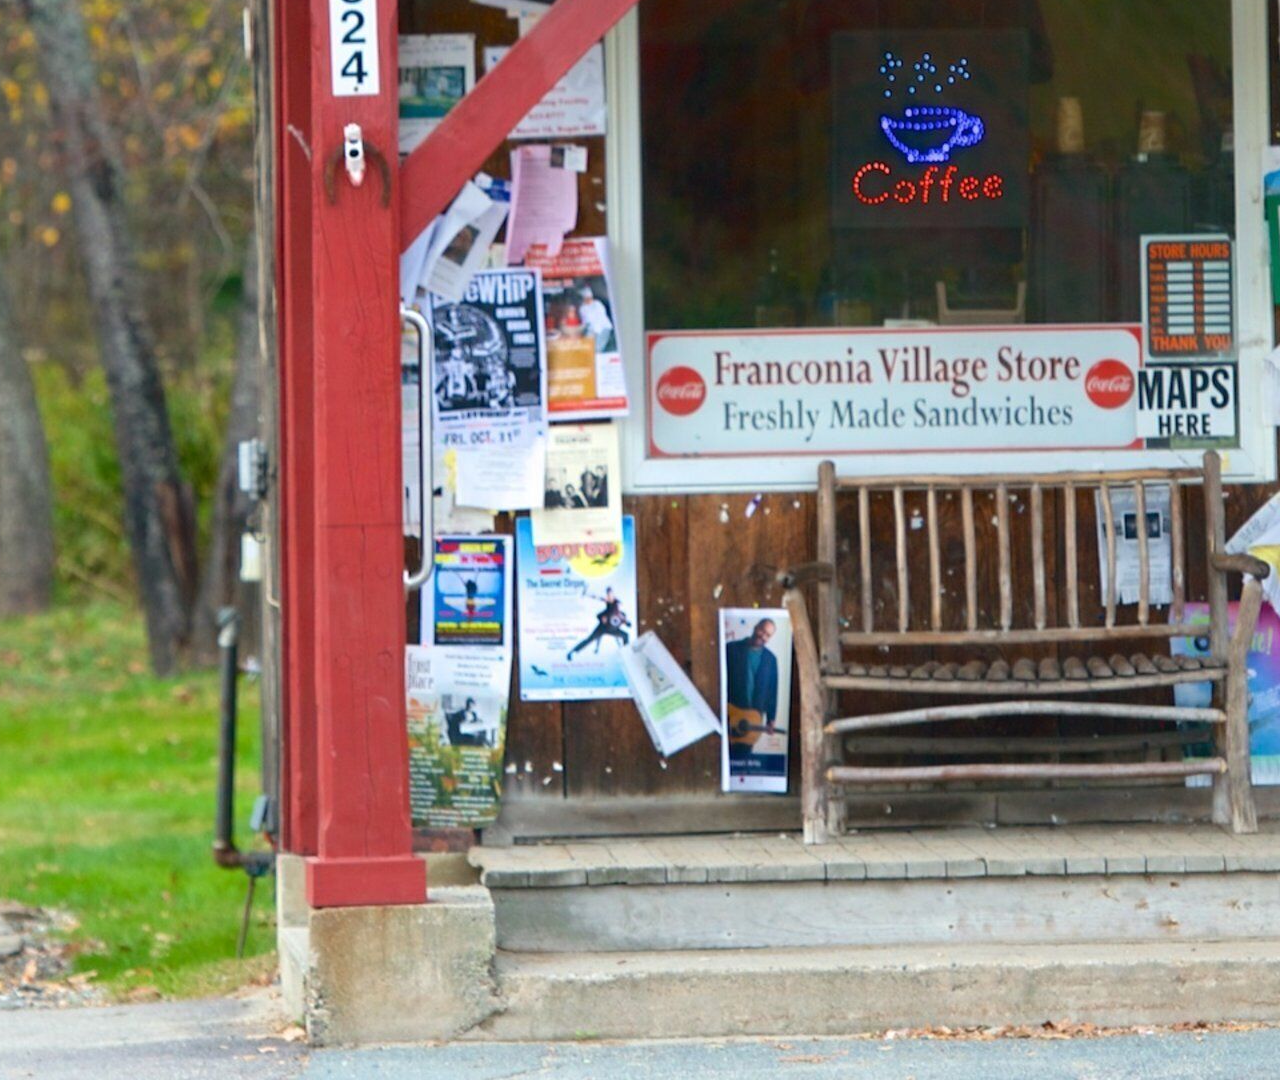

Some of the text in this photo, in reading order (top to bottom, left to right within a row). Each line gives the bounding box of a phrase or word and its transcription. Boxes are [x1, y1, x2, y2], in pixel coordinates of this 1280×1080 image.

[853, 162, 1003, 204] Coffee
[1150, 243, 1230, 259] STORE HOURS
[1151, 335, 1231, 352] THANK YOU
[714, 345, 1081, 398] Franconia Village Store
[1137, 367, 1230, 410] MAPS
[722, 395, 1074, 443] Freshly Made Sandwiches
[1158, 413, 1212, 436] HERE
